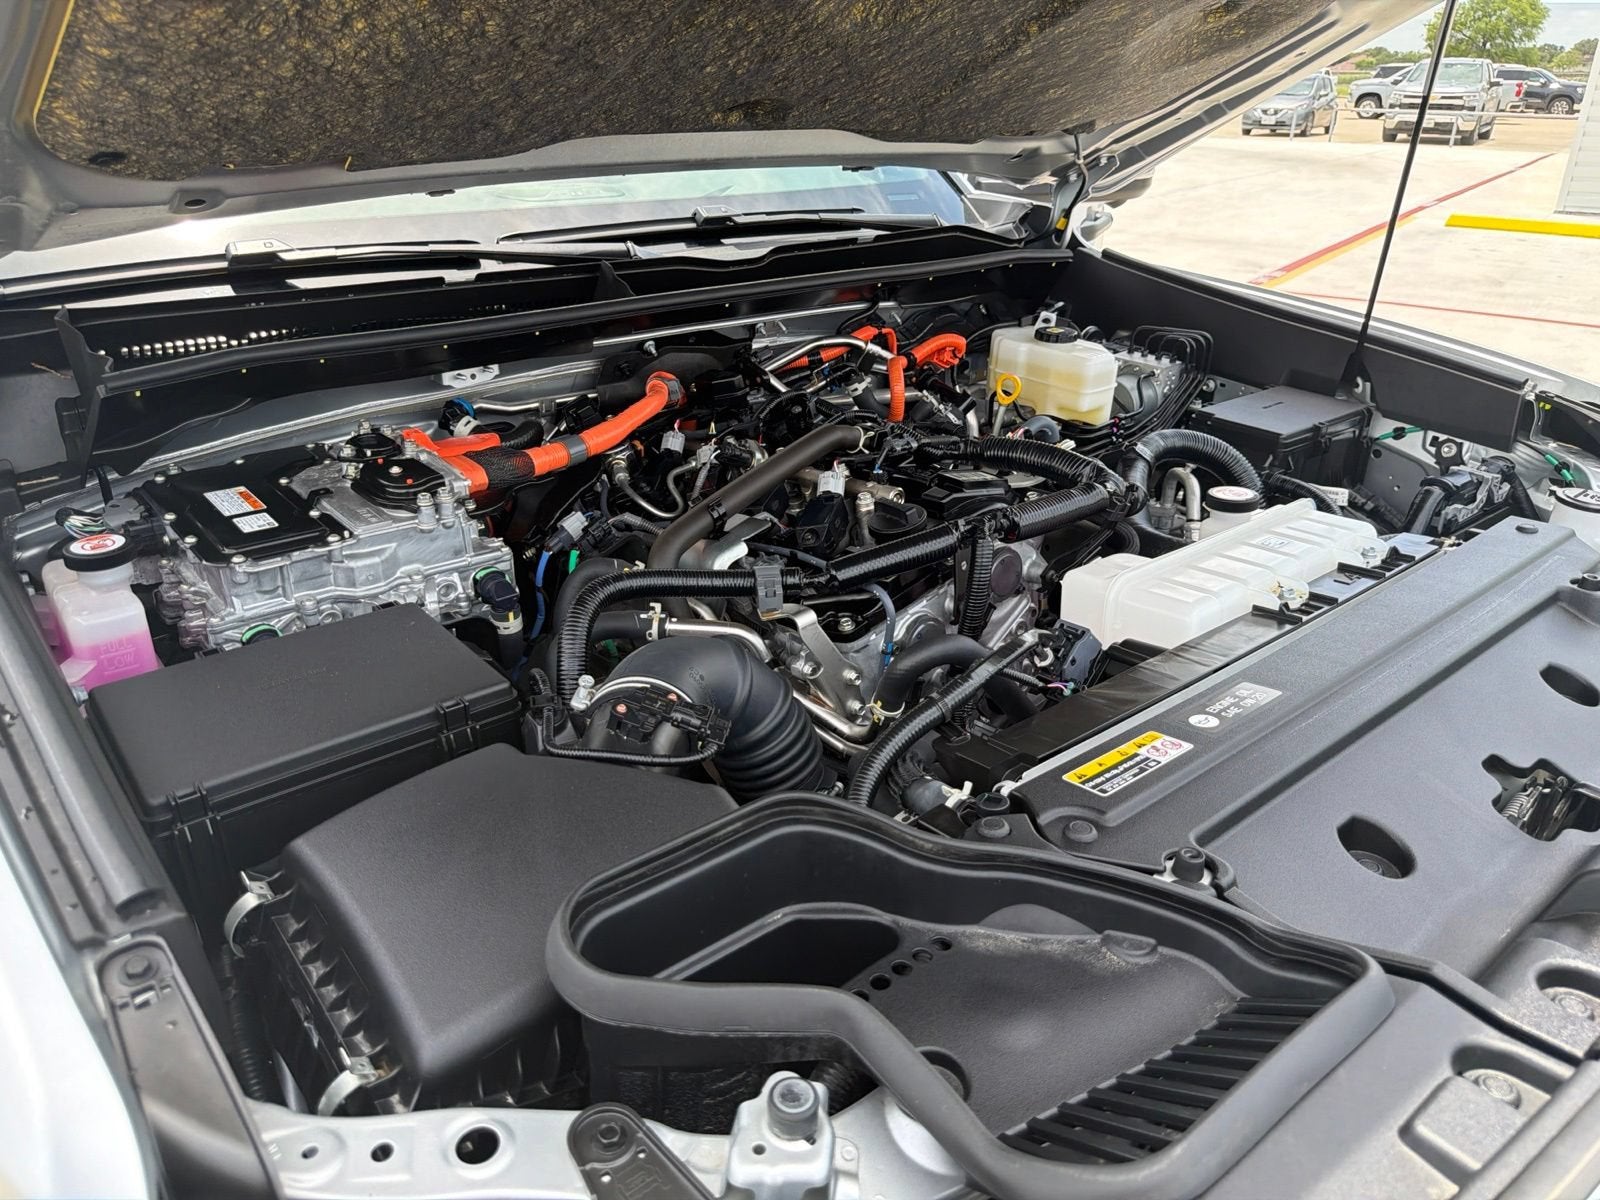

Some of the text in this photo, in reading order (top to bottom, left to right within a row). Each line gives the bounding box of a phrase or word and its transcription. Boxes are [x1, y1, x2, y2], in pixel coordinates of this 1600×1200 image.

[100, 635, 133, 655] FULL
[103, 650, 135, 670] LOW
[1205, 696, 1240, 714] ENGINE
[1220, 705, 1243, 718] SAE
